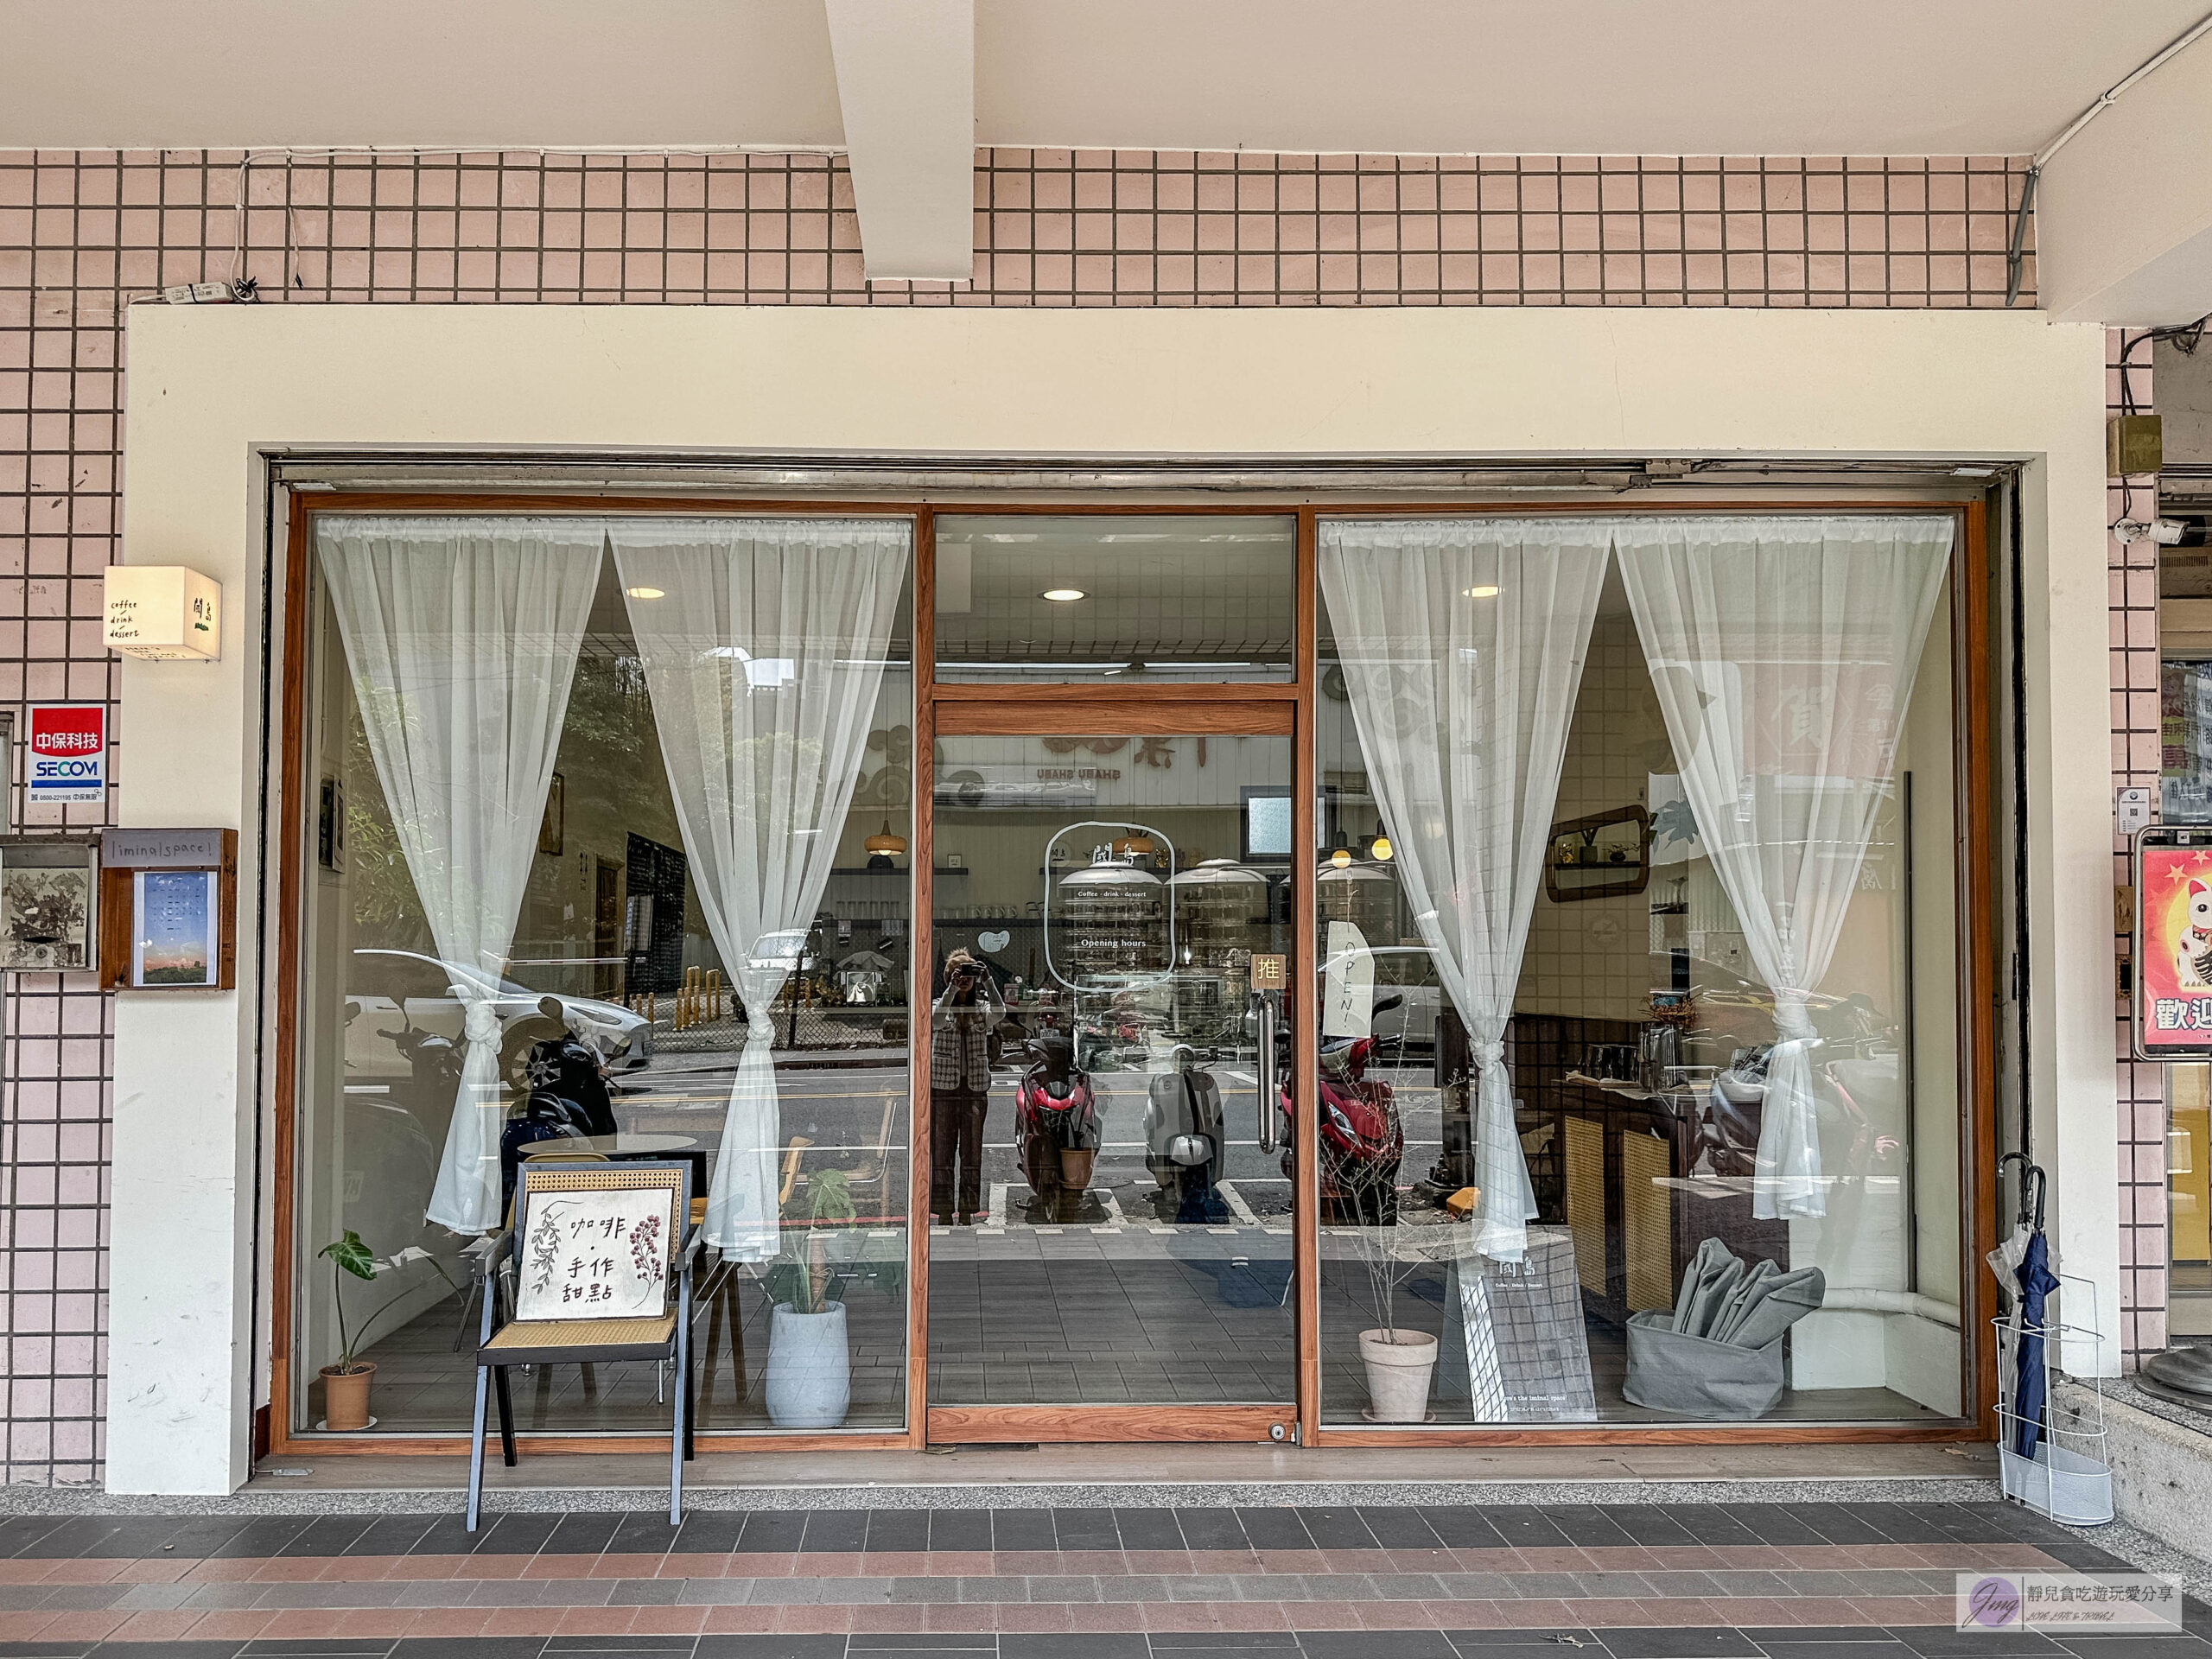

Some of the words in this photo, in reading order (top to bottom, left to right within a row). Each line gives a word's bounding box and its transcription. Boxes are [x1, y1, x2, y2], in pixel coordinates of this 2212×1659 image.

[111, 600, 137, 609] coffee
[110, 614, 134, 624] drink
[109, 629, 139, 639] dessert
[35, 733, 99, 749] 中保科技
[36, 761, 98, 776] SECOM
[1081, 939, 1118, 948] Opening
[1258, 957, 1280, 979] 推
[570, 1217, 626, 1239] 咖啡
[567, 1256, 614, 1279] 手作
[562, 1283, 613, 1303] 甜點
